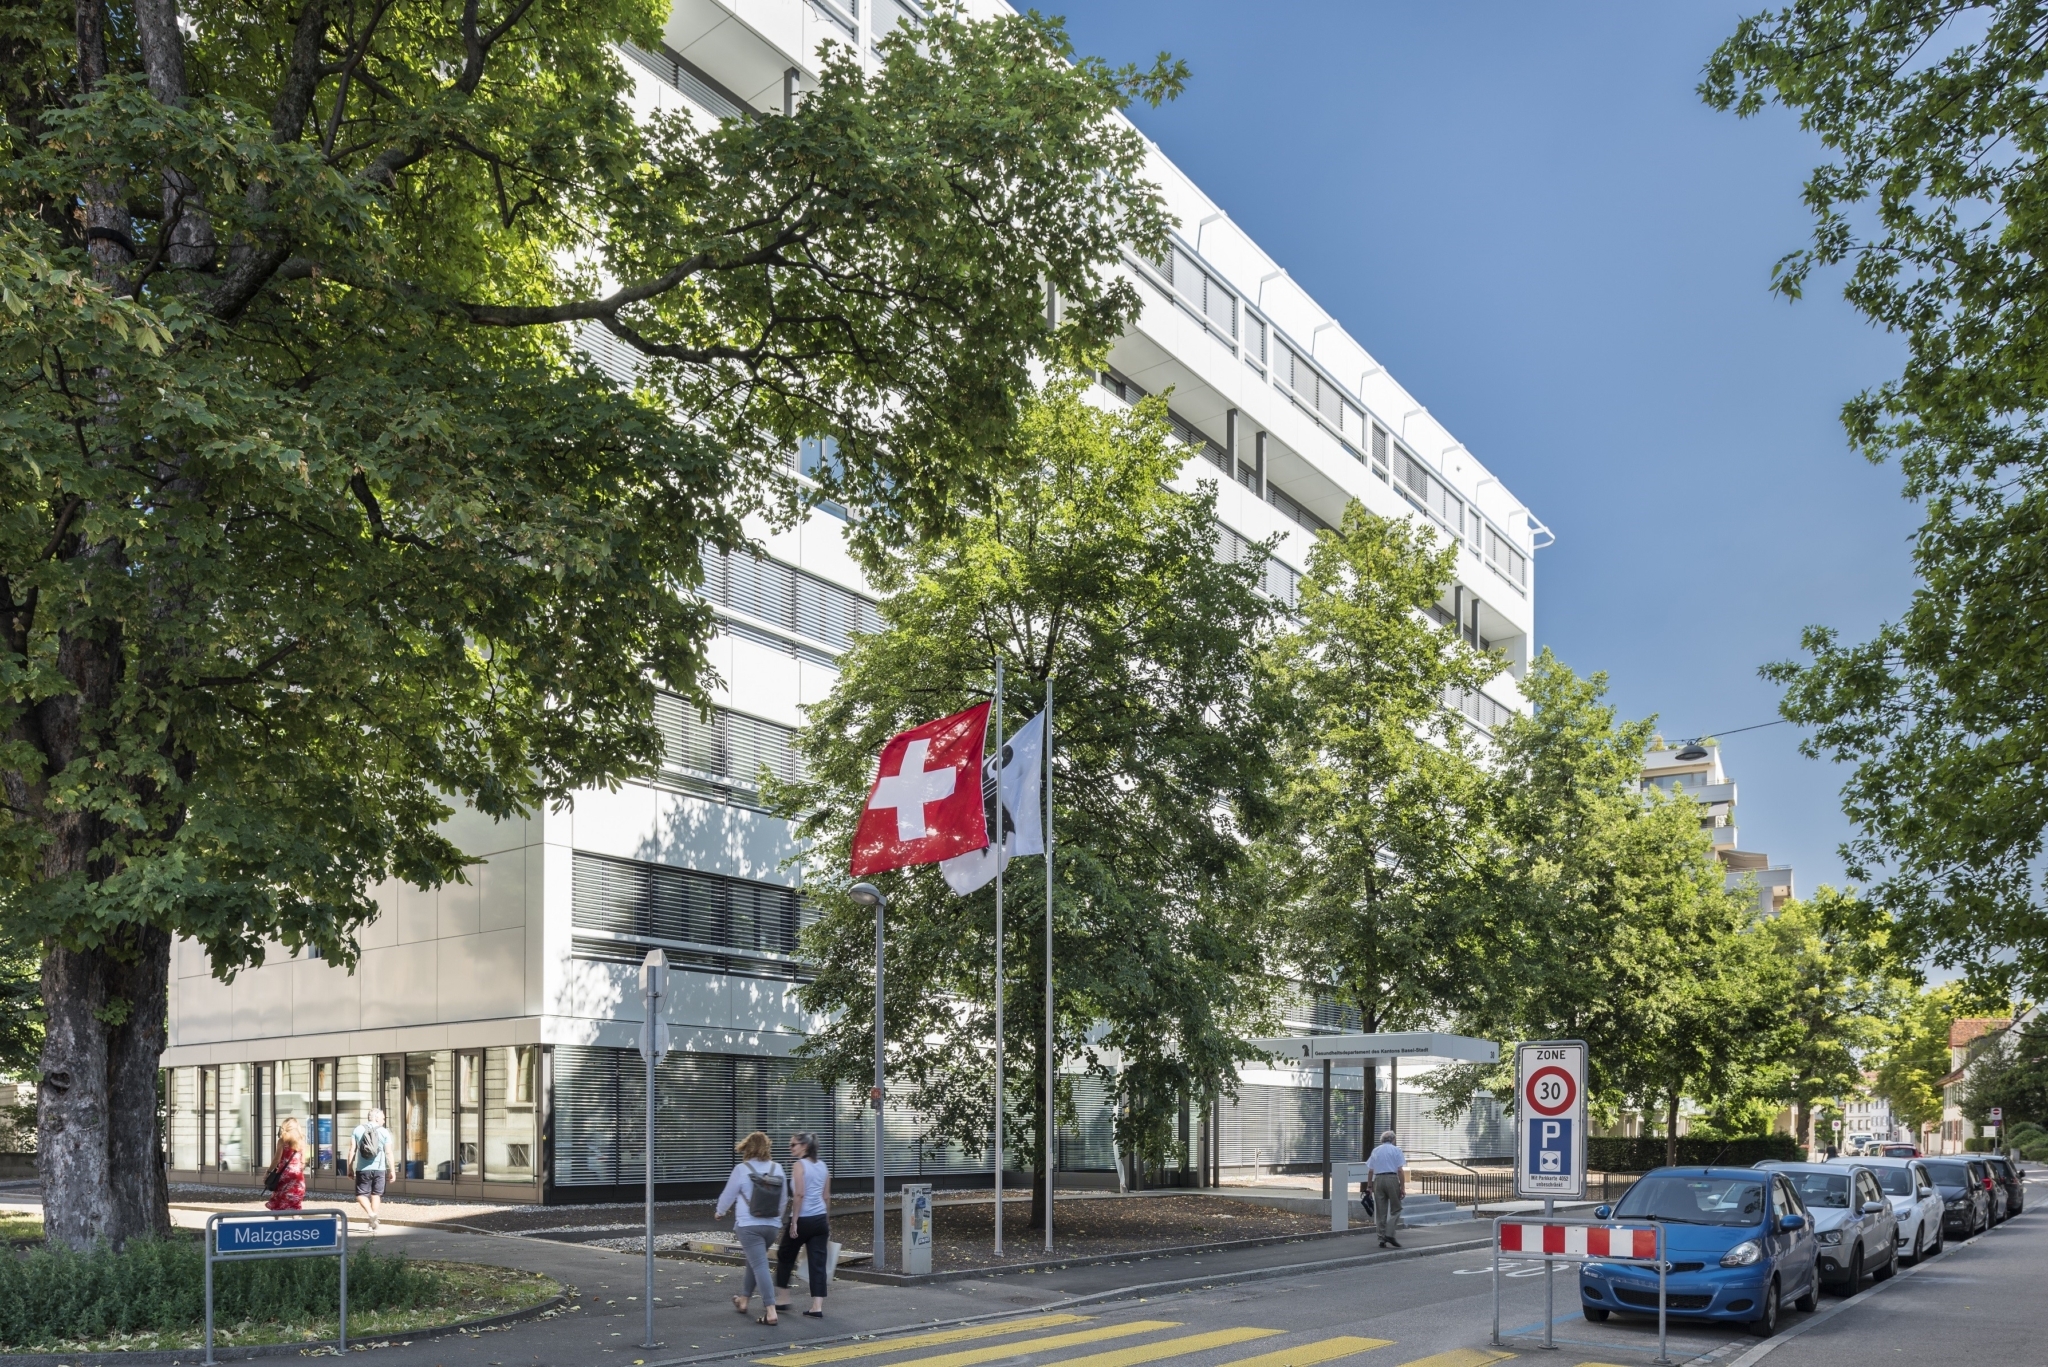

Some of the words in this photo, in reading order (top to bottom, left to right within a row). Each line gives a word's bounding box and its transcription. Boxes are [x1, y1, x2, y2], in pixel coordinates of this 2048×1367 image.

[1536, 1050, 1566, 1060] ZONE
[1540, 1081, 1561, 1100] 30
[1541, 1121, 1561, 1149] P
[234, 1226, 320, 1246] Malzgasse
